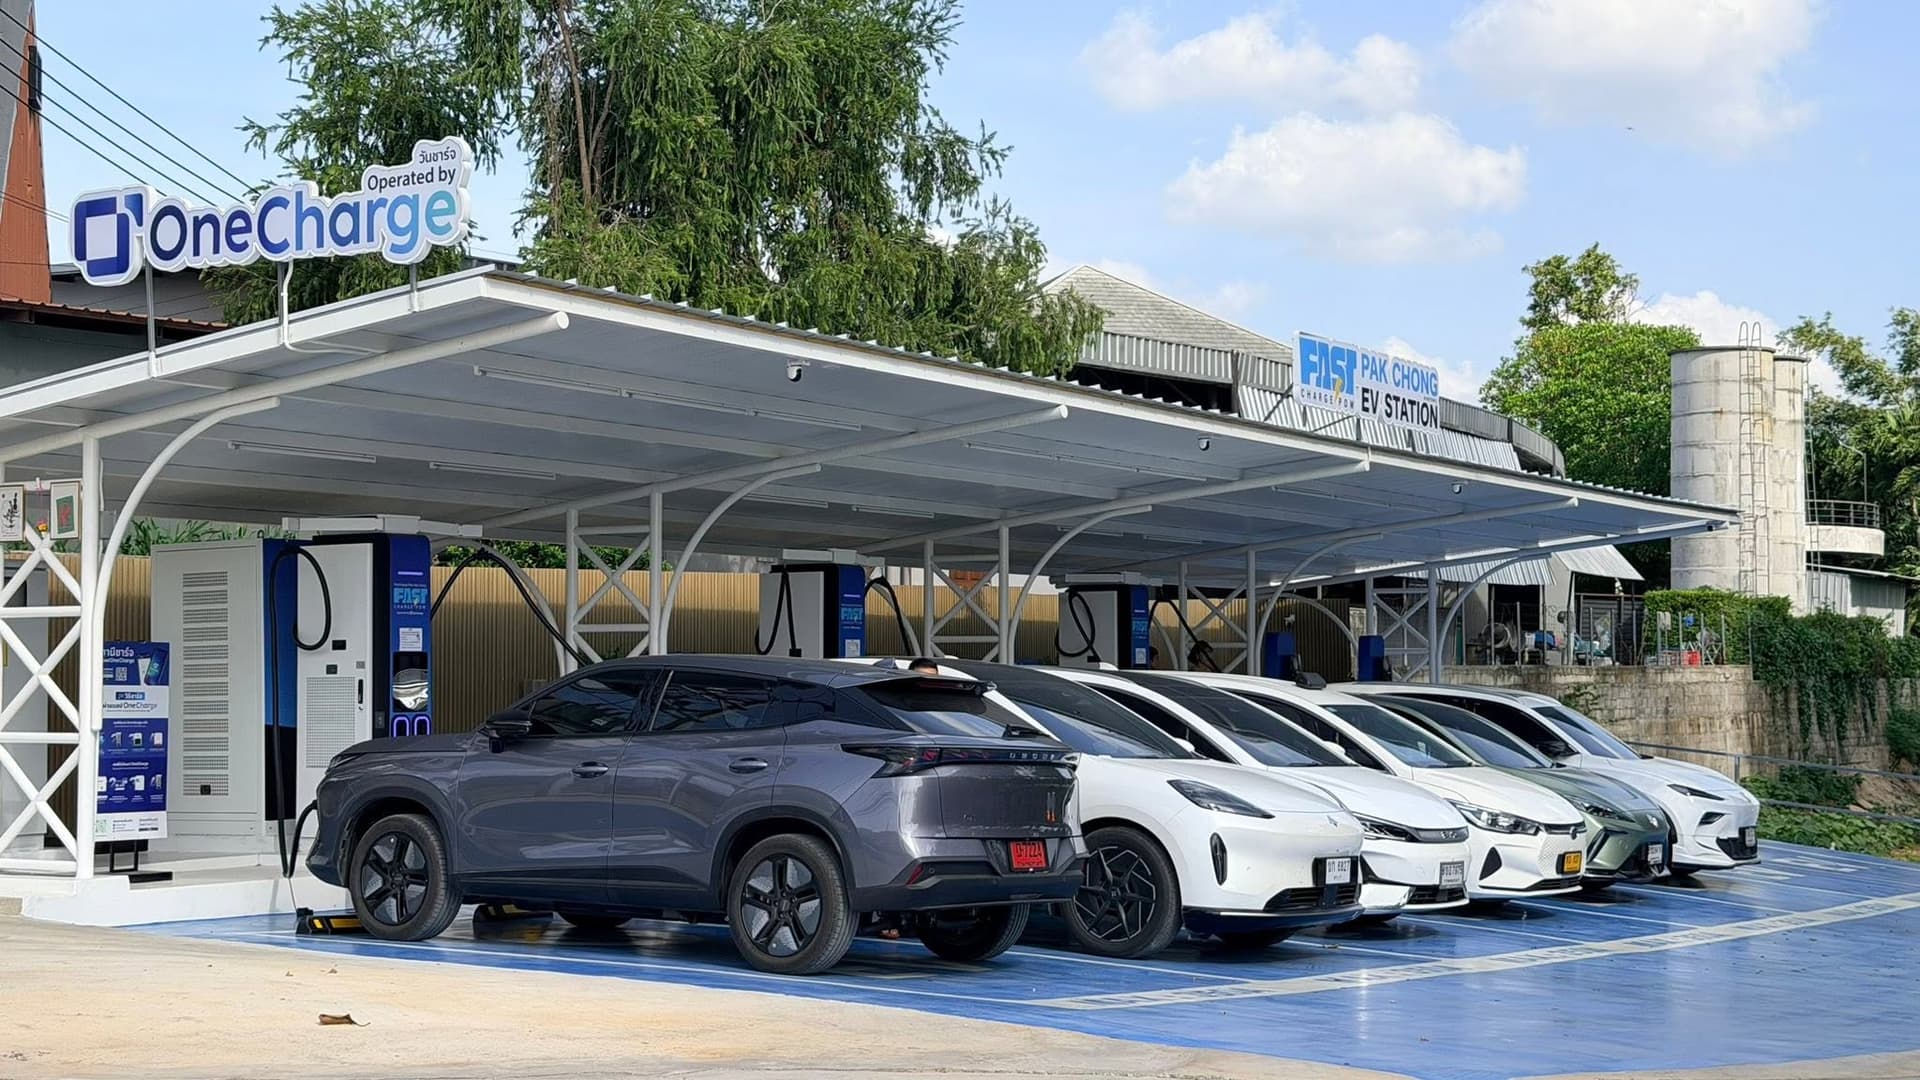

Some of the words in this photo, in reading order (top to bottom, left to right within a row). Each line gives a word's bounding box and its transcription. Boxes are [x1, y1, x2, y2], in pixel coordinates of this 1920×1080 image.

[419, 146, 457, 164] วันชาร์จ
[367, 167, 434, 194] Operated
[438, 162, 457, 185] by
[150, 190, 457, 261] OneCharge
[1299, 337, 1357, 395] FAST
[1361, 353, 1388, 384] PAK
[1392, 361, 1439, 397] CHONG
[1300, 388, 1334, 405] CHARGE
[1361, 386, 1380, 414] EV
[1384, 393, 1438, 429] STATION
[393, 587, 428, 605] FAST
